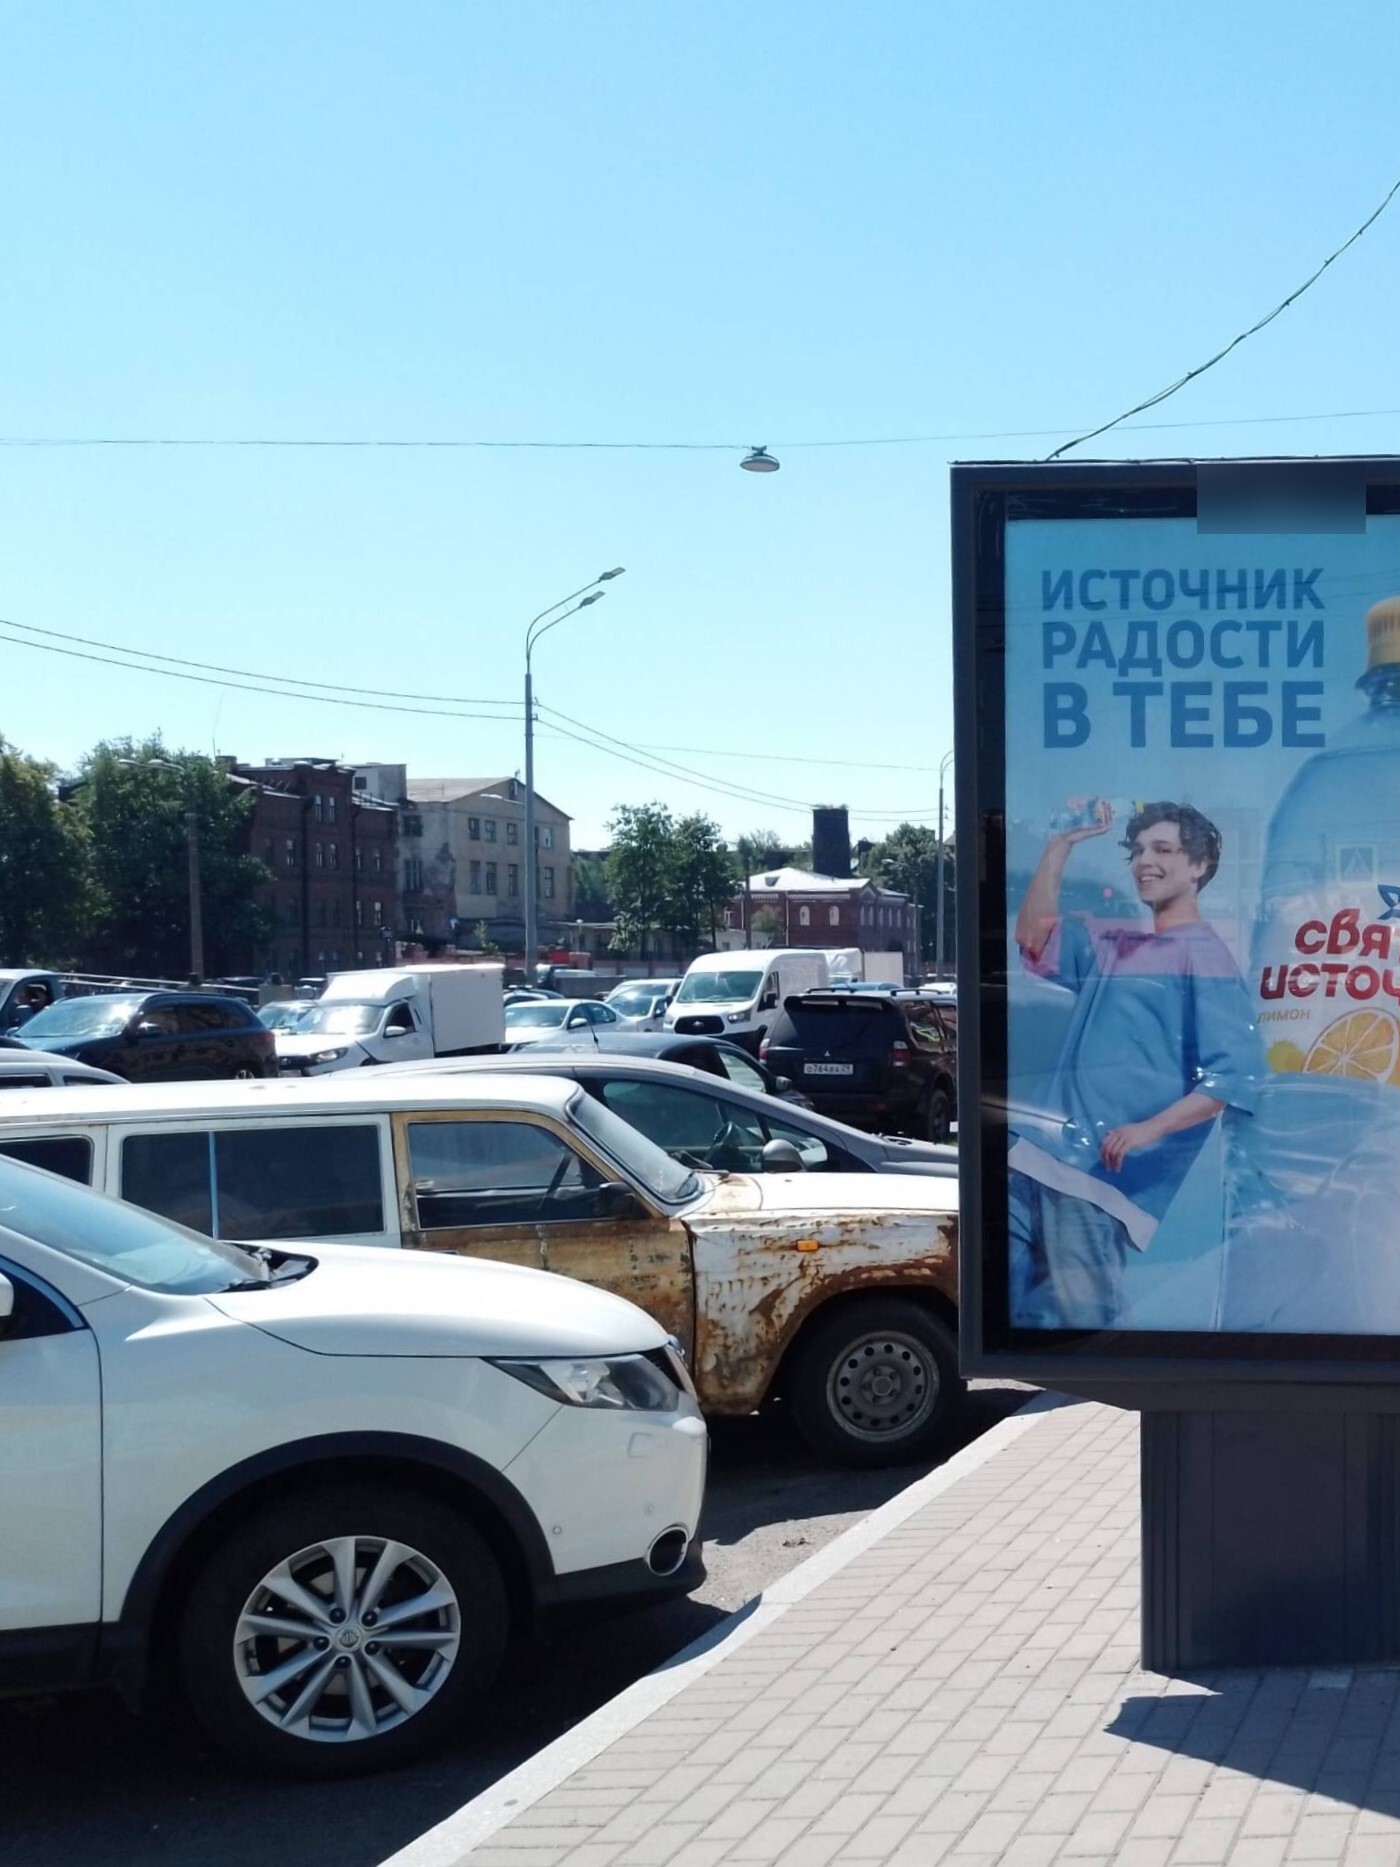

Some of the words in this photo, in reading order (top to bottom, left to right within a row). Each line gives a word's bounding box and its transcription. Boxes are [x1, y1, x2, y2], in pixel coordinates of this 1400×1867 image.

[1041, 567, 1325, 611] ИСТОЧНИК
[1041, 619, 1325, 677] РАДОСТИ
[1043, 682, 1092, 749] В
[1113, 681, 1326, 748] ТЕБЕ
